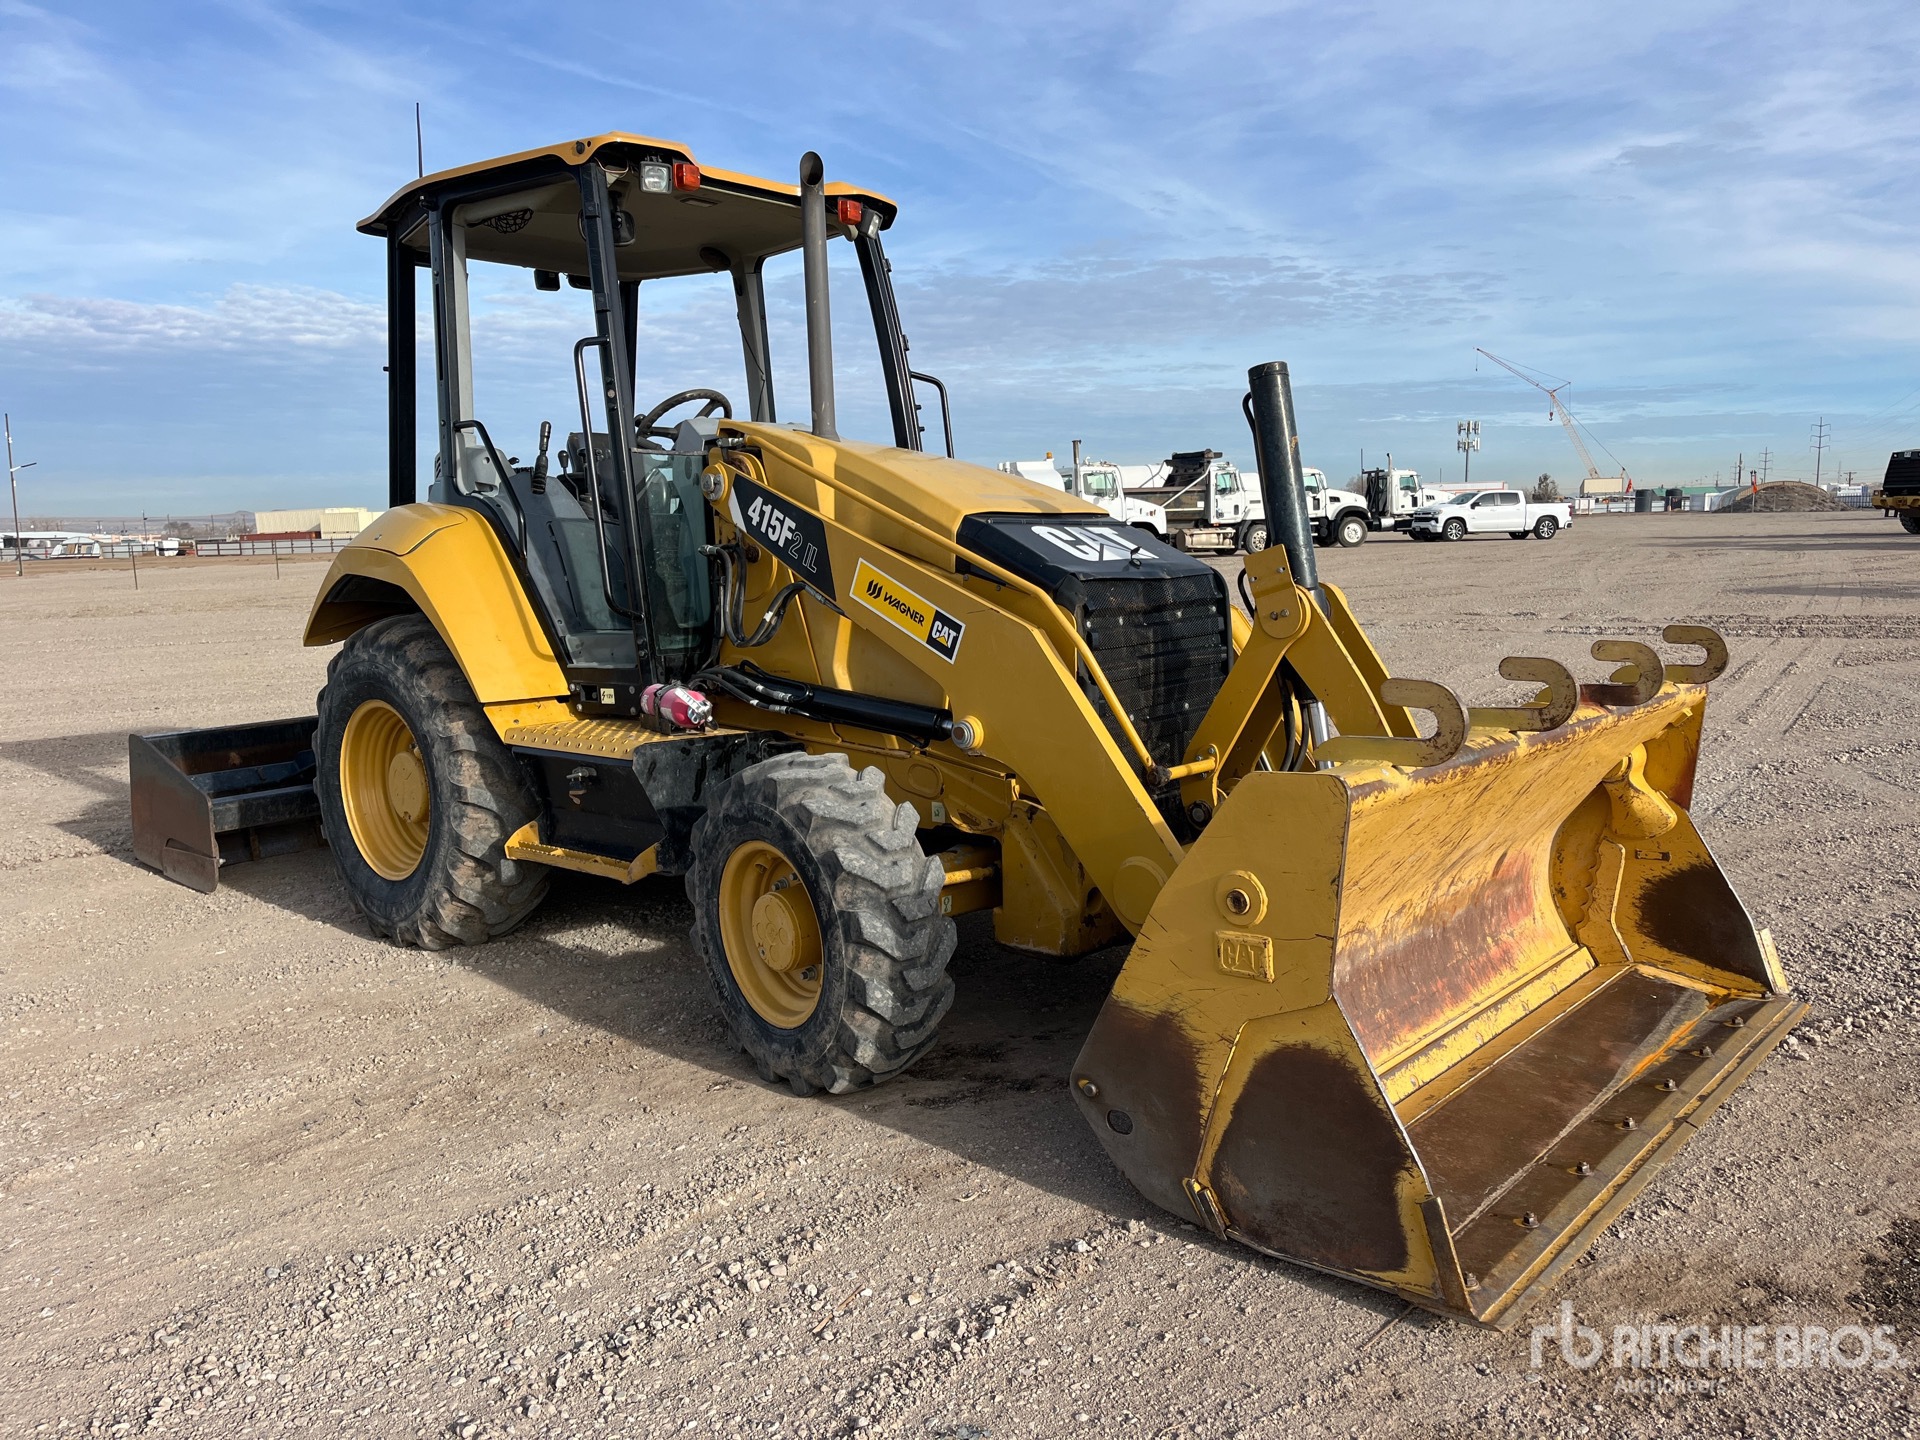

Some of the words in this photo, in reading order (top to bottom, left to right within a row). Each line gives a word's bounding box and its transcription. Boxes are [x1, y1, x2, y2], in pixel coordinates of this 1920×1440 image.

[1031, 525, 1160, 562] CAT
[883, 592, 925, 628] WAGNER
[931, 620, 957, 649] CAT
[1221, 939, 1264, 975] CAT
